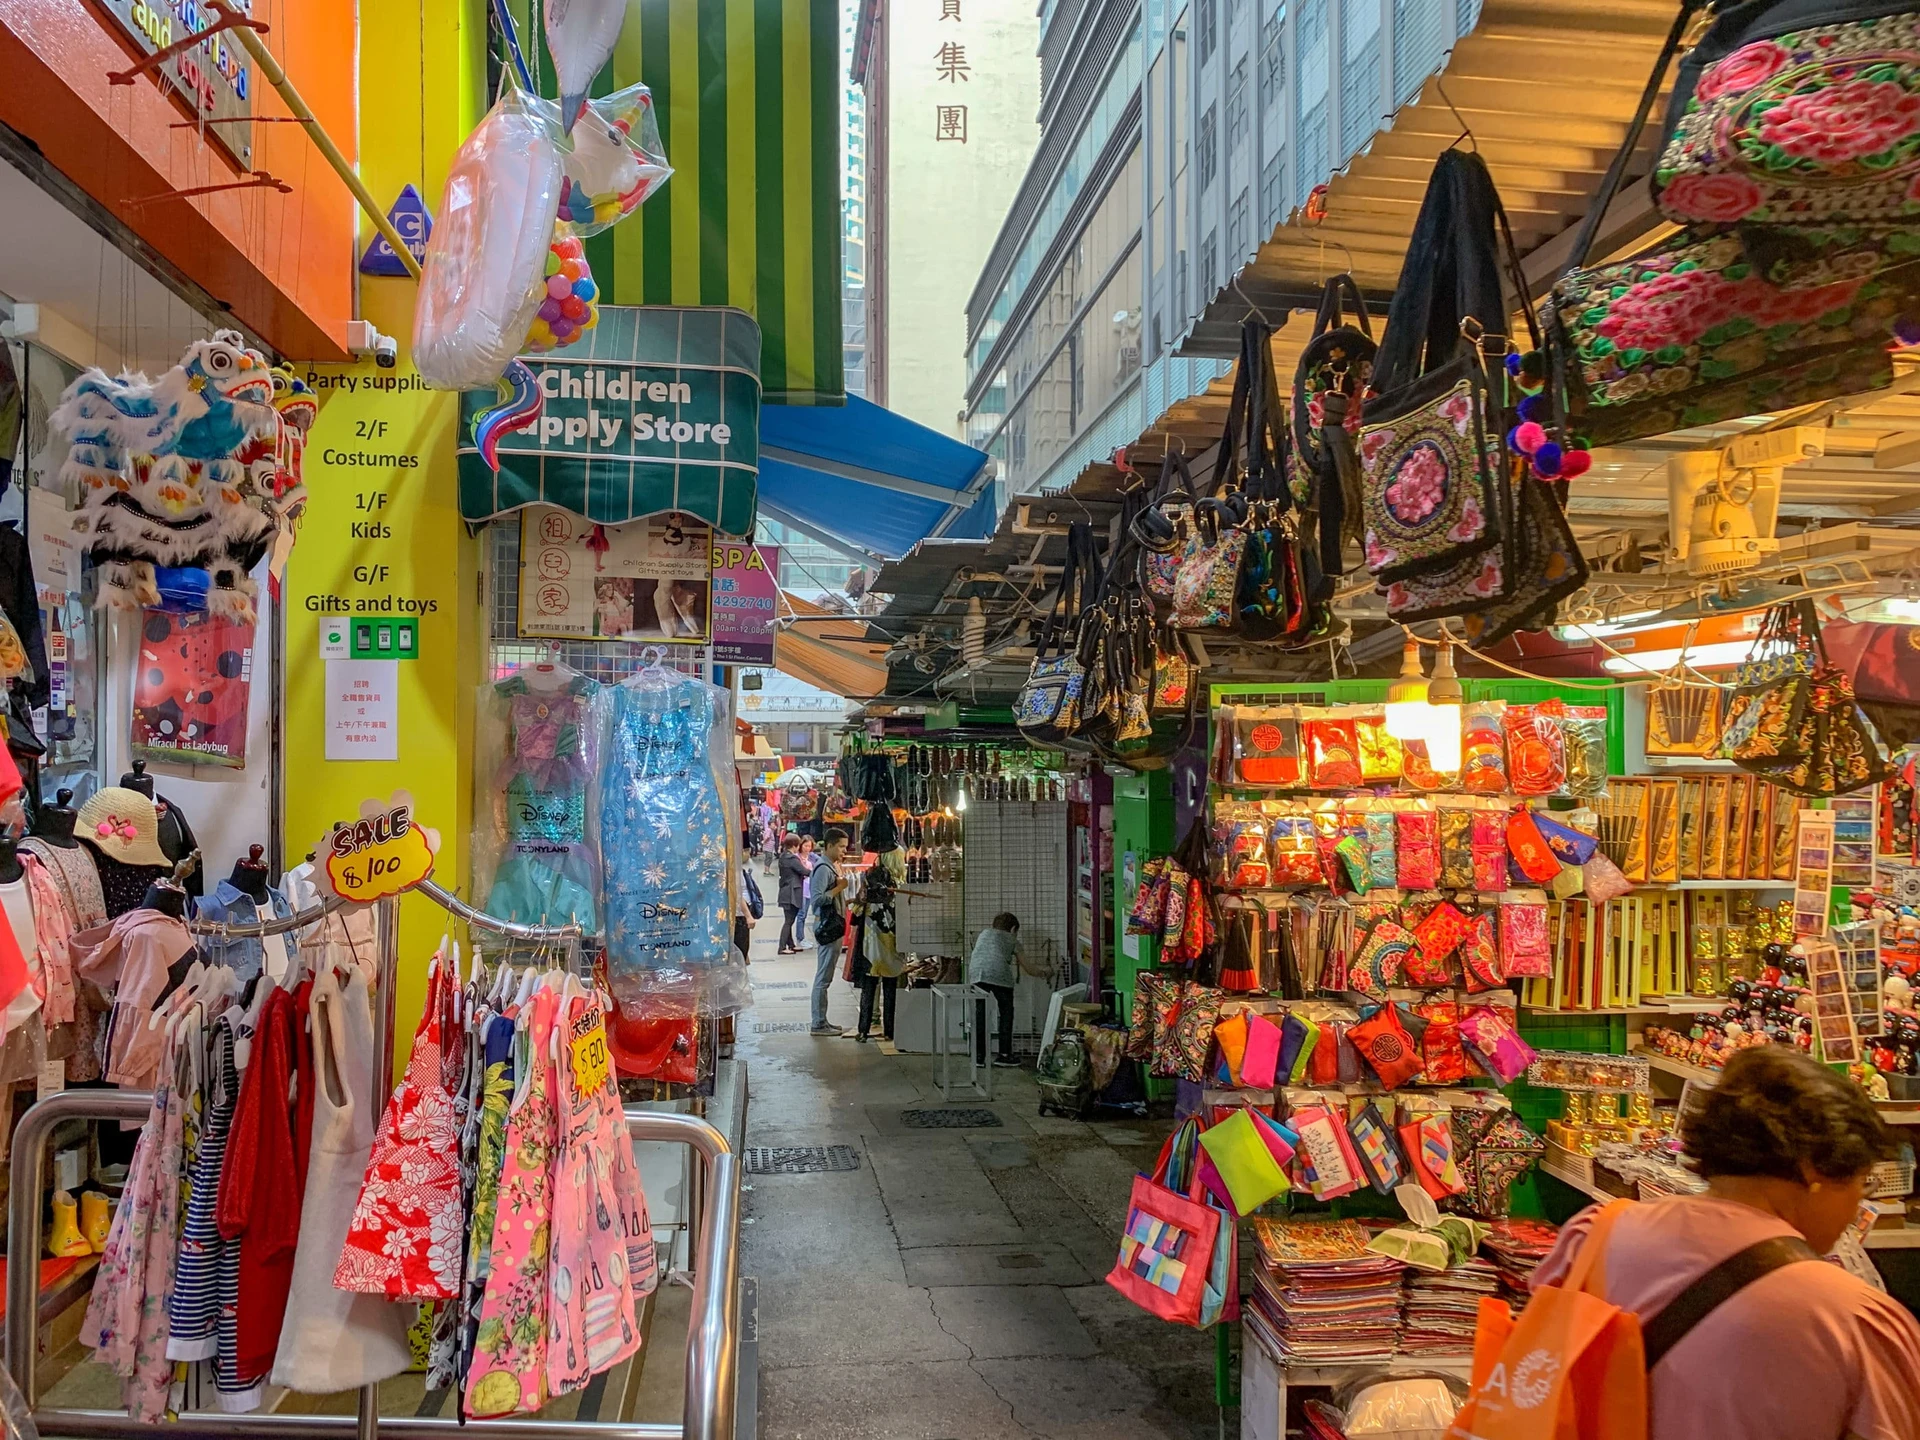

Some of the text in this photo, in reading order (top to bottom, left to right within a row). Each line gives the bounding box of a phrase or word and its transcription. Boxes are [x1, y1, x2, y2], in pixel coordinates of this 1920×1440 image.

[176, 50, 216, 112] toys
[379, 240, 426, 255] Cub
[306, 372, 433, 394] Party supplie
[536, 368, 692, 404] Children
[355, 419, 388, 440] 2/F
[517, 409, 732, 447] upply Store
[322, 448, 419, 468] Costumes
[355, 491, 388, 512] 1/F
[351, 521, 391, 539] Kids
[658, 561, 684, 569] Supply
[713, 547, 765, 571] SPA
[353, 564, 389, 585] G/F
[638, 567, 659, 575] Gifts
[678, 569, 694, 577] toys
[305, 594, 438, 616] Gifts and toys
[714, 595, 773, 610] 4292740
[148, 737, 229, 754] Miraculus Ladybug
[516, 802, 571, 827] Disney
[331, 806, 411, 858] SALE
